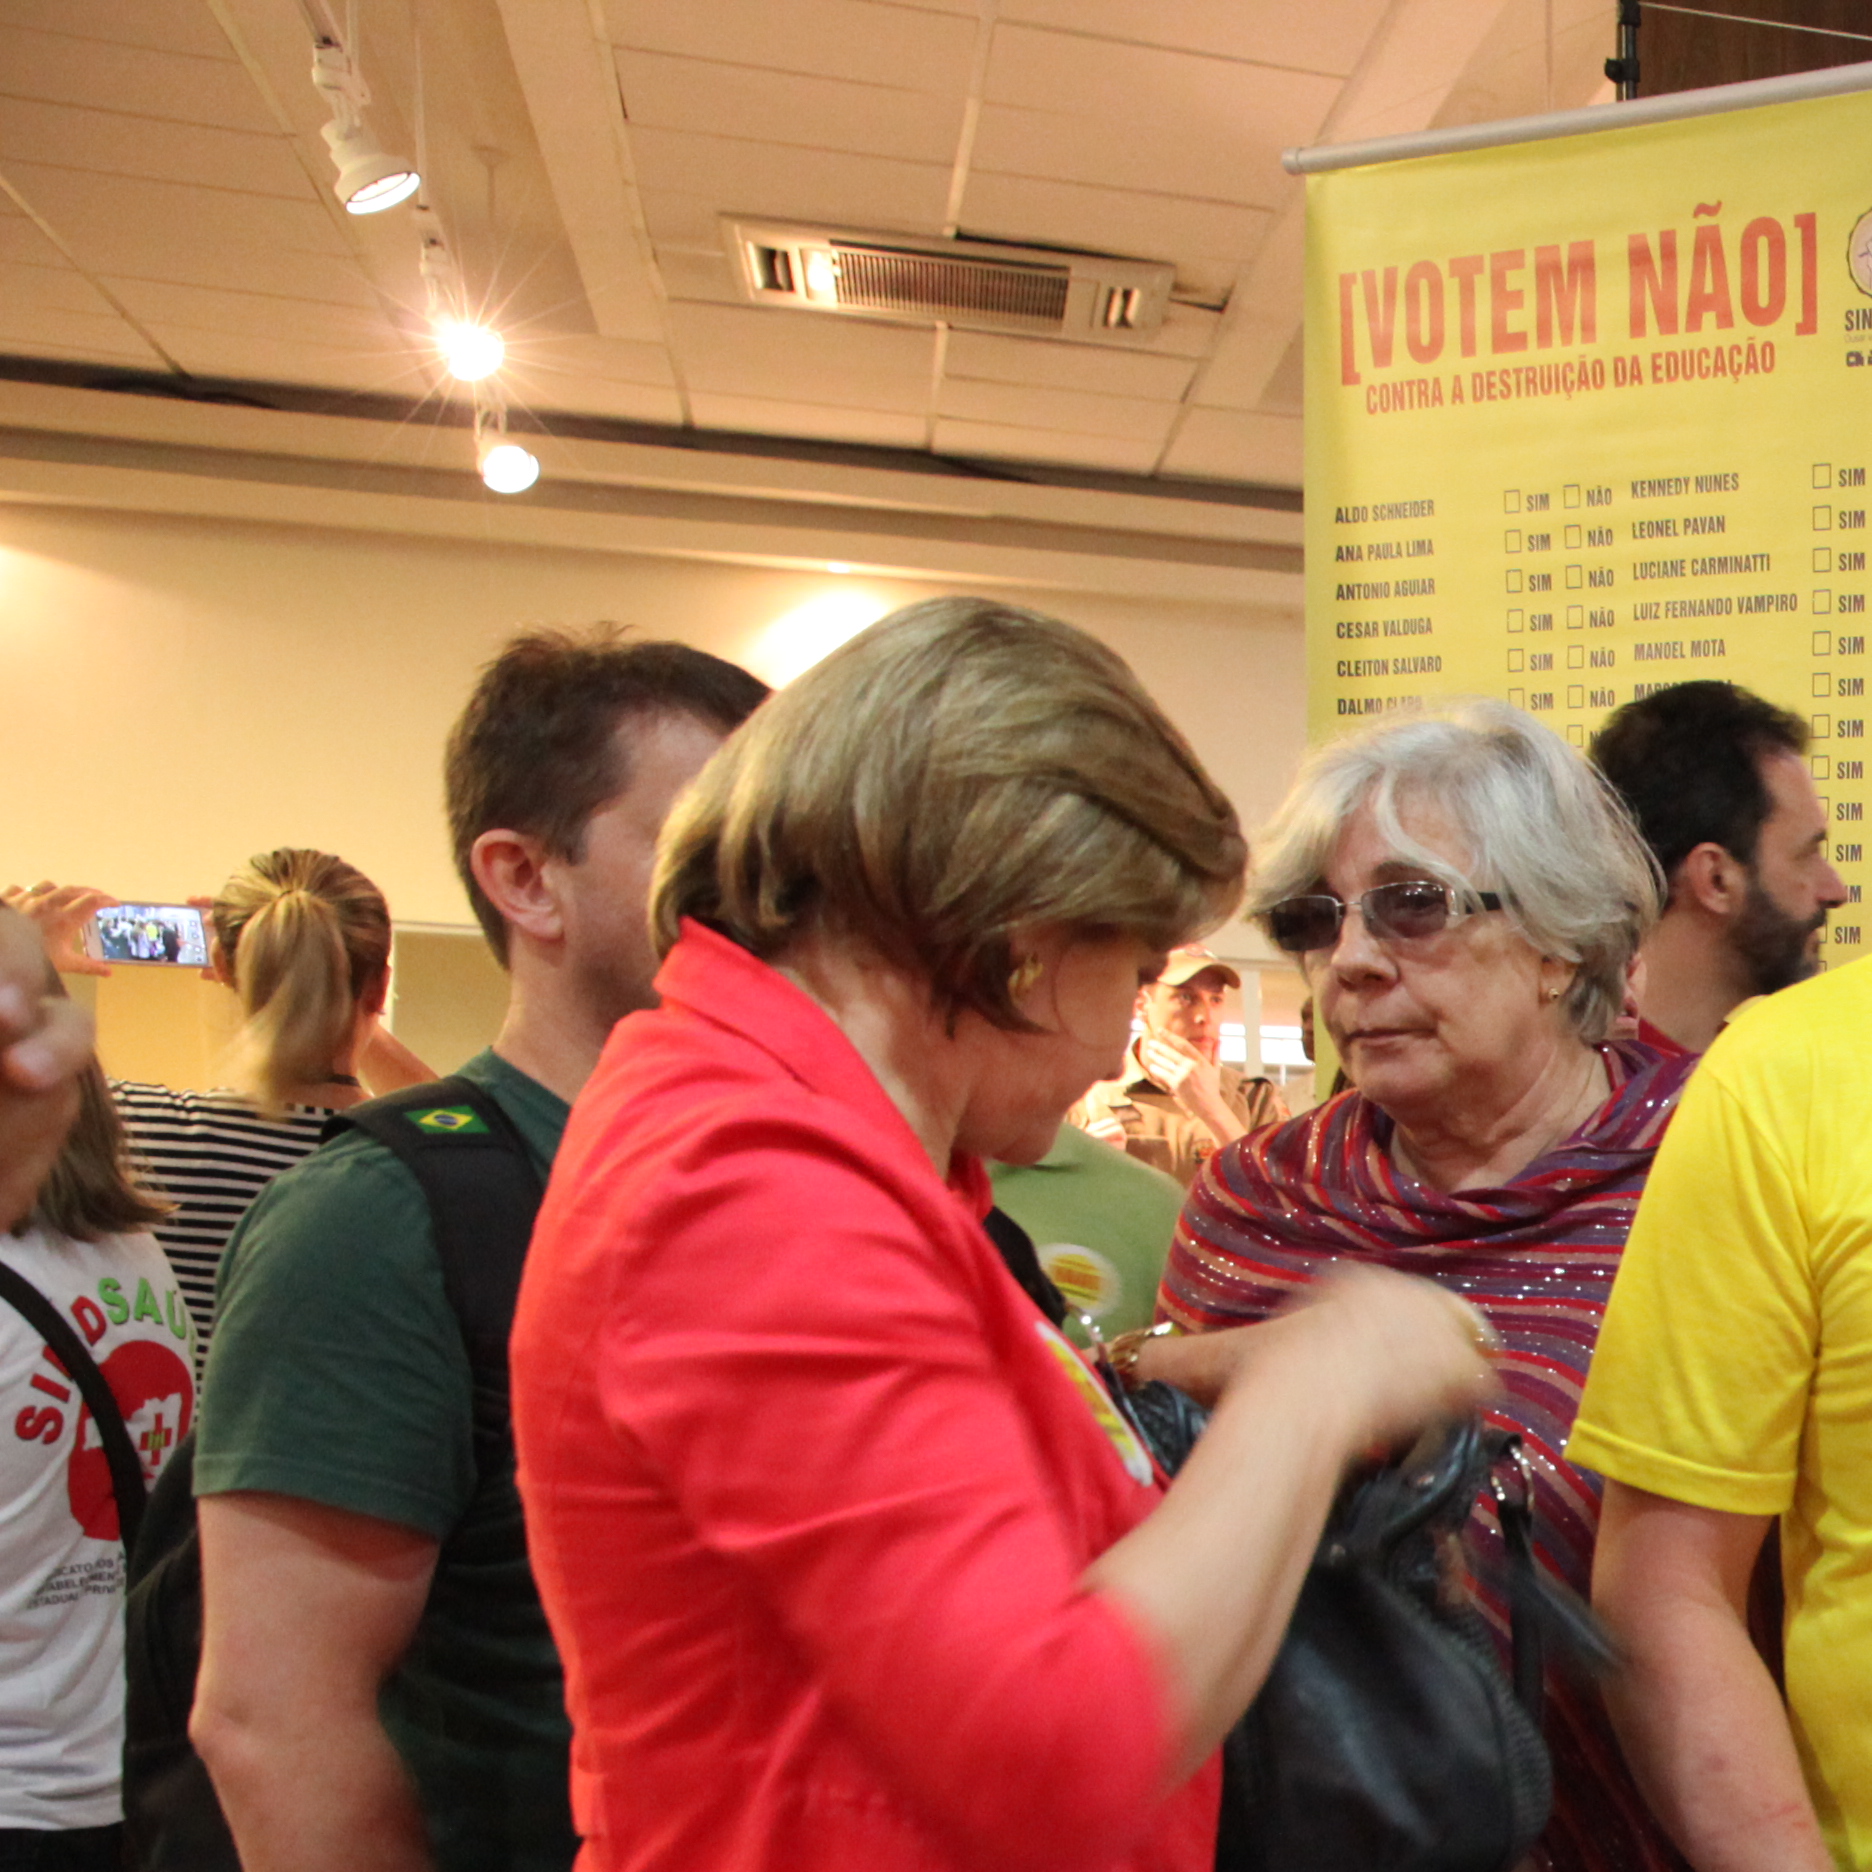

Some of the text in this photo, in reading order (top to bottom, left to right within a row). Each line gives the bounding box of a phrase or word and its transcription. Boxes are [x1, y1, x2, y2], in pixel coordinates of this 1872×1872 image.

[1339, 200, 1818, 387] [VOTEM NÃO]
[1366, 336, 1776, 415] CONTRA A DESTRUIÇÃO DA EDUCAÇÃO
[1631, 476, 1690, 499] KENNEDY
[1695, 472, 1739, 495] NUNES
[1838, 468, 1866, 487] SIM
[1335, 485, 1613, 524] ALDO SCHNEIDER SIM NÃO
[1632, 519, 1679, 540] LEONEL
[1683, 515, 1725, 535] PAVAN
[1838, 510, 1866, 529] SIM
[1335, 526, 1613, 562] ANA PAULA LIMA SIM NÃO
[1633, 559, 1686, 580] LUCIANE
[1691, 553, 1770, 577] CARMINATTI
[1838, 552, 1865, 571] SIM
[1336, 566, 1614, 601] ANTONIO AGUIAR SIM NÃO
[1633, 602, 1660, 621] LUIZ
[1665, 597, 1732, 619] FERNANDO
[1737, 593, 1798, 615] VAMPIRO
[1838, 594, 1865, 613] SIM
[1336, 606, 1615, 639] CESAR VALDUGA SIM NÃO
[1337, 647, 1615, 677] CLEITON SALVARO SIM NÃO
[1634, 641, 1686, 661] MANOEL
[1690, 638, 1726, 658] MOTA
[1838, 636, 1865, 655] SIM
[1337, 697, 1382, 715] DALMO
[1530, 693, 1554, 711] SIM
[1590, 687, 1615, 708] NÃO
[1837, 678, 1864, 696] SIM
[1837, 720, 1864, 738] SIM
[1836, 761, 1863, 779] SIM
[1836, 803, 1862, 821] SIM
[1835, 844, 1862, 862] SIM
[1834, 926, 1861, 944] SIM
